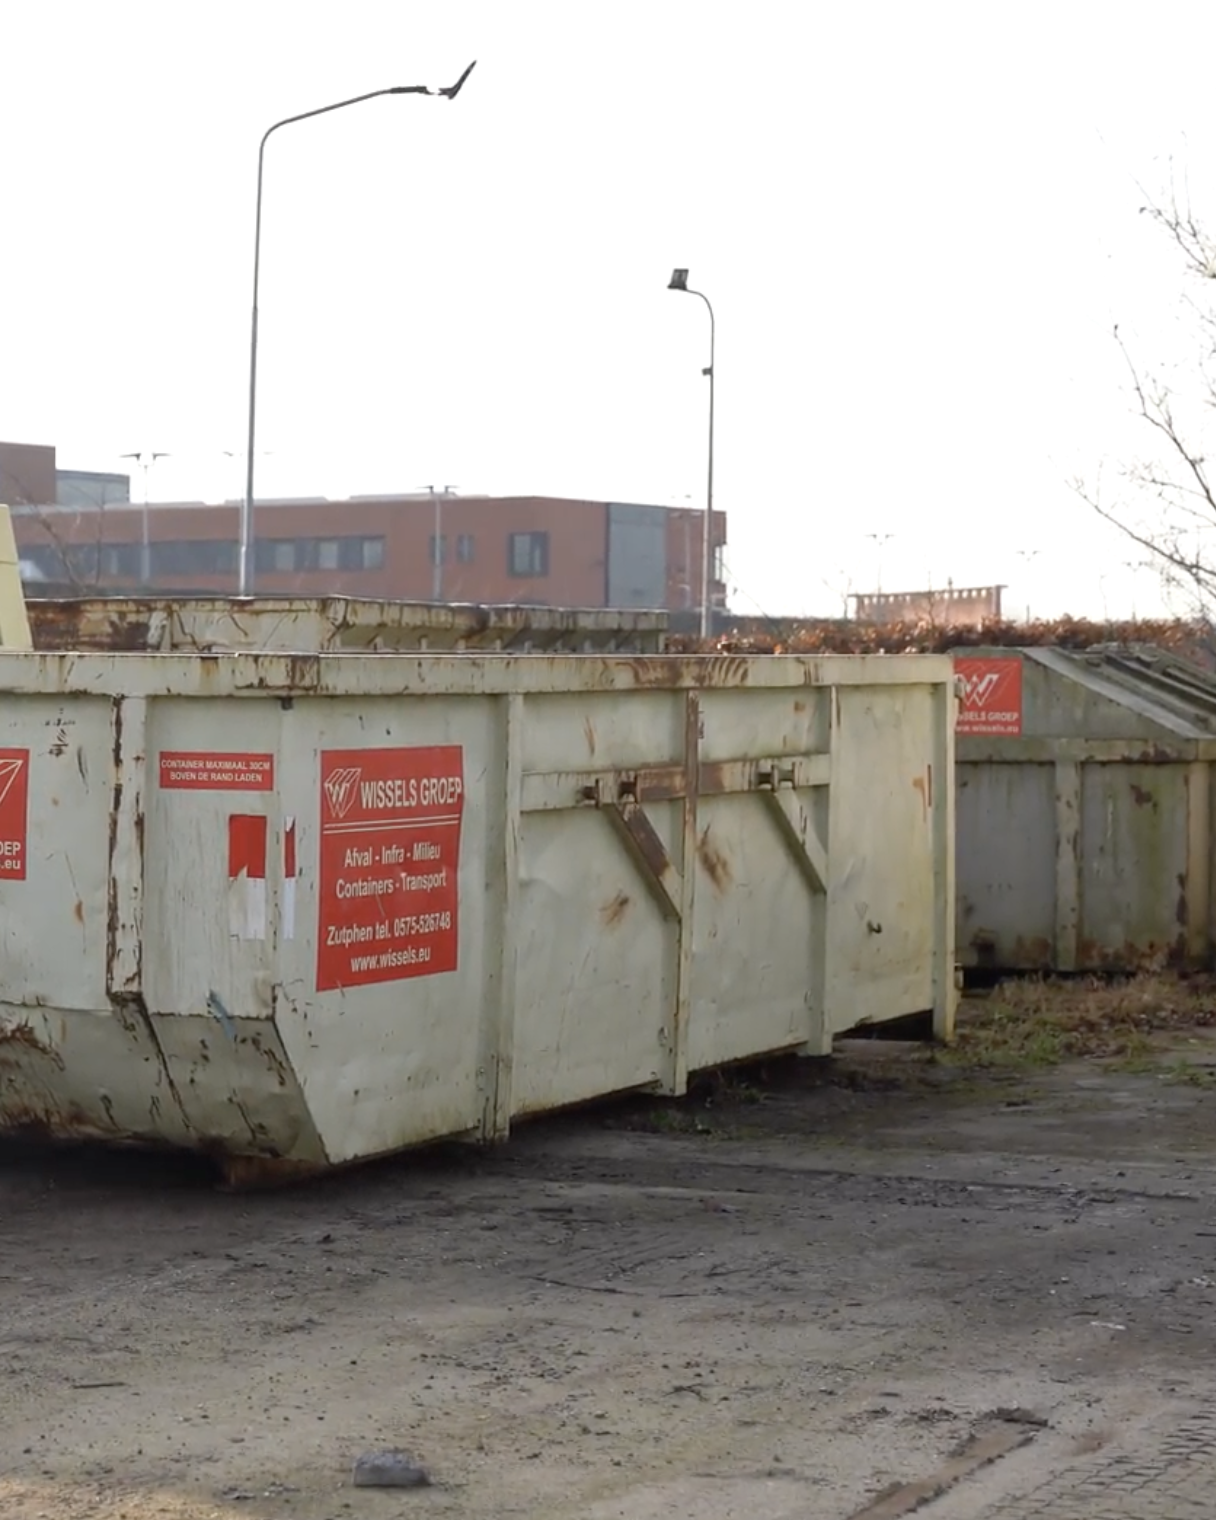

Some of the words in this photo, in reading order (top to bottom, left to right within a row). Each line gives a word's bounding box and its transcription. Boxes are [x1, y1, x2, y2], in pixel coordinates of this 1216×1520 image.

[161, 759, 205, 770] CONTAINER
[206, 760, 247, 771] MAXIMAAL
[170, 771, 196, 782] BOVEN
[197, 772, 210, 781] DE
[211, 772, 234, 782] RAND
[235, 773, 263, 783] LADEN
[360, 778, 418, 810] WISSELS
[420, 776, 463, 807] GROEP
[344, 846, 372, 868] Afval
[382, 844, 404, 865] Infra
[412, 842, 441, 861] Milieu
[336, 877, 394, 899] Containers
[400, 867, 446, 893] Transport
[327, 923, 373, 948] Zutphen
[375, 920, 391, 940] tel.
[393, 911, 451, 936] 0575-526748
[351, 946, 431, 973] www.wissels.eu
